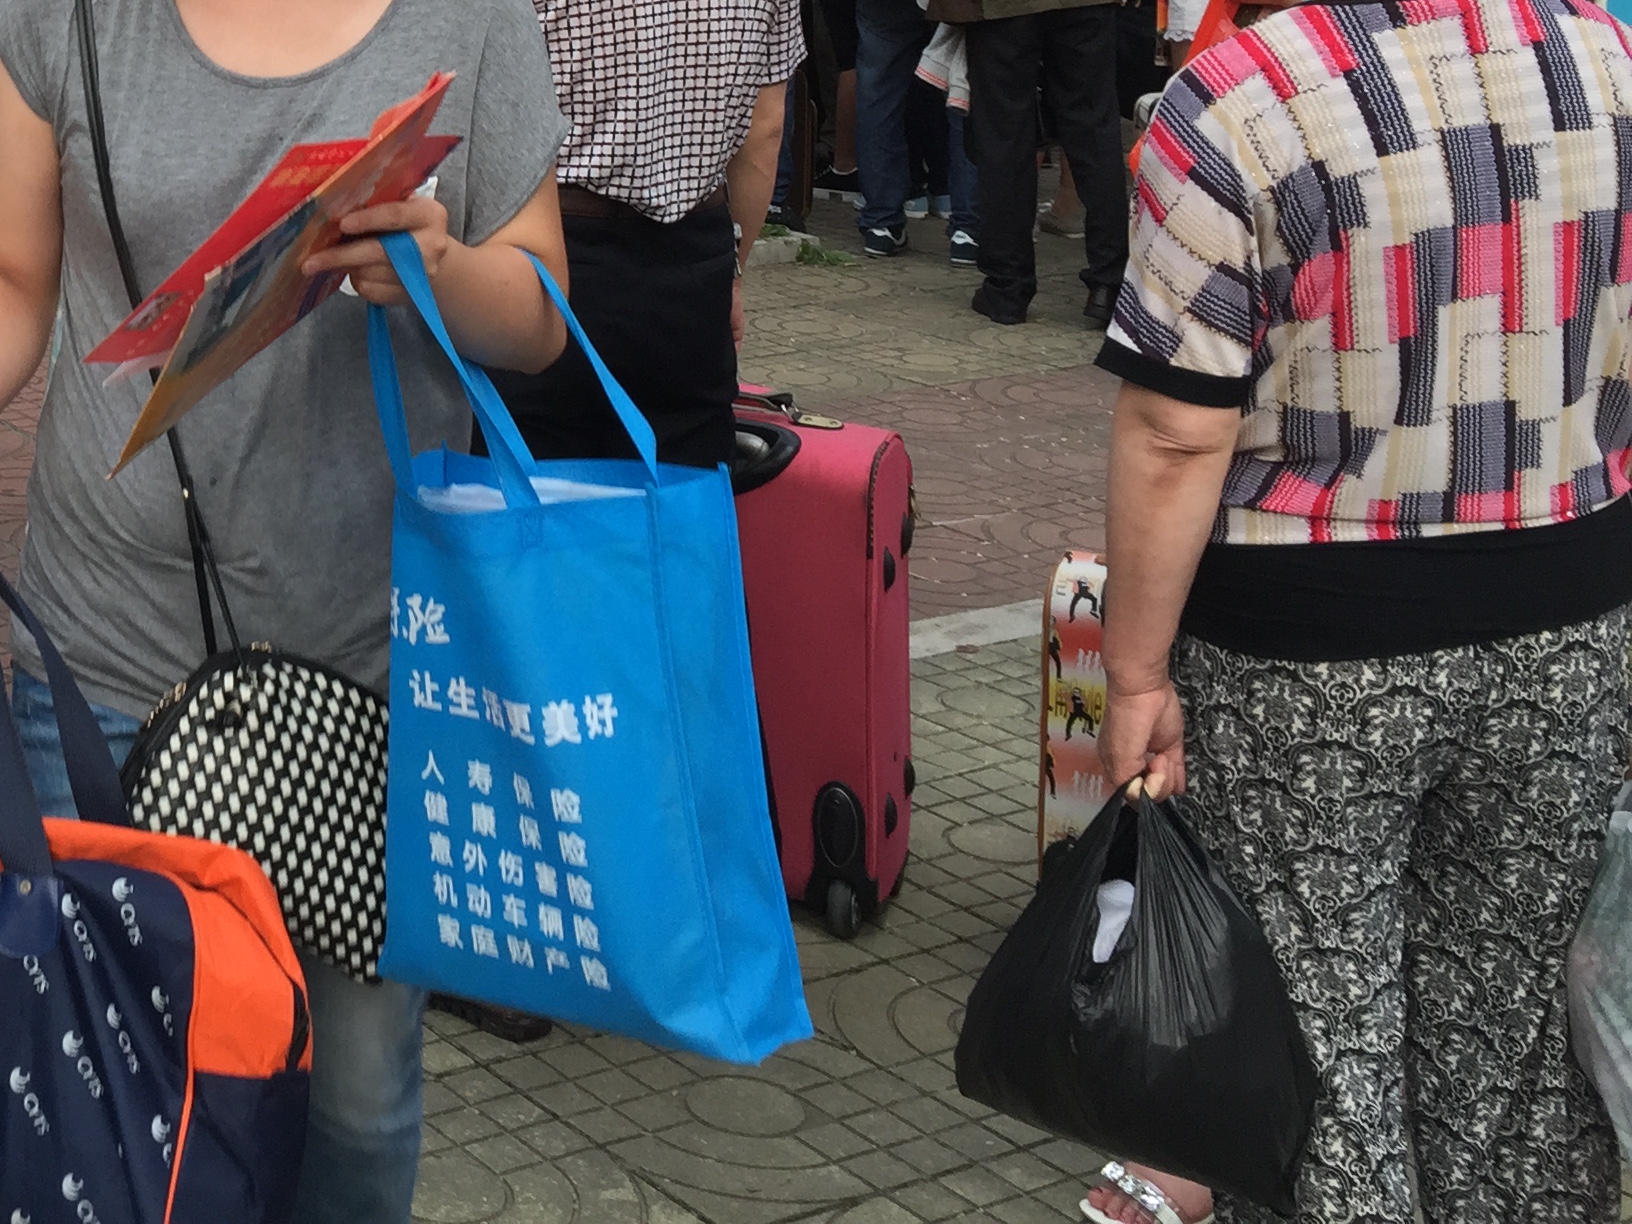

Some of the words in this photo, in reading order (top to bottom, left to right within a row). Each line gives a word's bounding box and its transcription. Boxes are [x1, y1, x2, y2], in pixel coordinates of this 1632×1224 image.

[409, 669, 618, 747] 让生活更美好
